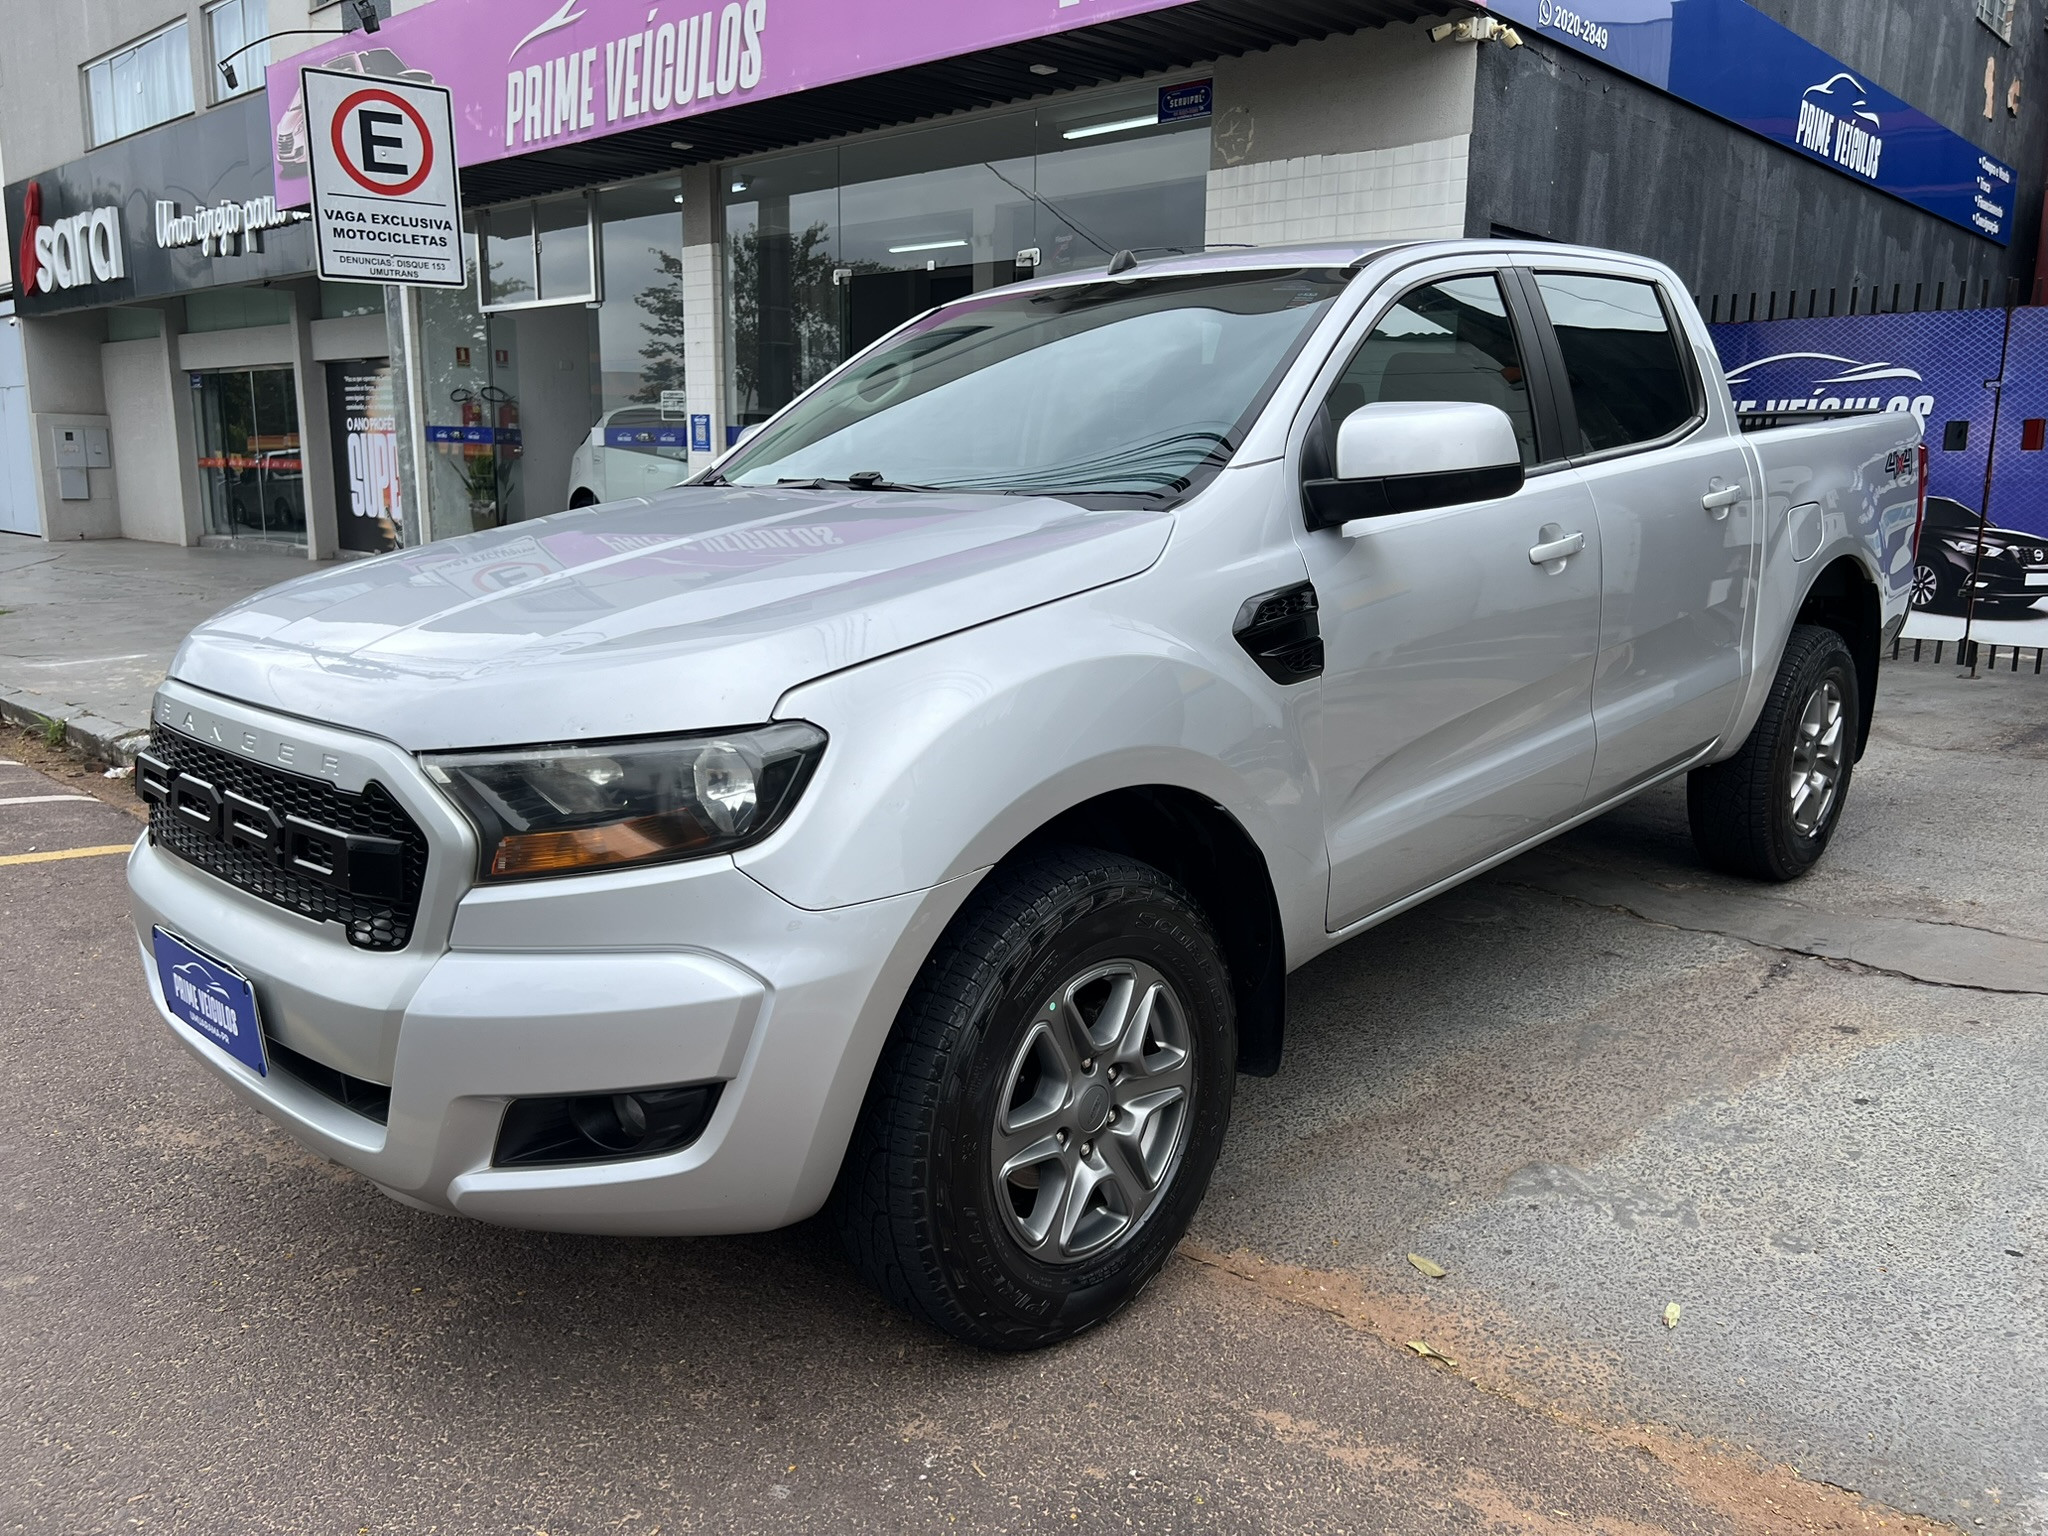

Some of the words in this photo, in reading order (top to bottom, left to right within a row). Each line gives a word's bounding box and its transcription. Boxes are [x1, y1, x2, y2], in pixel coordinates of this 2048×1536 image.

[1553, 5, 1608, 50] 2020-2849
[506, 47, 597, 147] PRIME
[606, 0, 767, 122] VEÍCULOS
[358, 109, 409, 175] E
[1795, 99, 1835, 158] PRIME
[1834, 119, 1882, 179] VEÍCULOS
[323, 208, 367, 224] VAGA
[371, 213, 453, 231] EXCLUSIVA
[332, 227, 448, 247] MOTOCICLETAS
[35, 205, 124, 294] sara
[339, 255, 395, 267] DENUNCIAS:
[397, 259, 430, 271] DISQUE
[432, 262, 446, 271] 153
[369, 267, 420, 279] UMUTRANS
[346, 417, 354, 431] O
[135, 751, 351, 893] FORD
[173, 972, 200, 1011] PRIME
[198, 988, 239, 1037] VEÍCULOS
